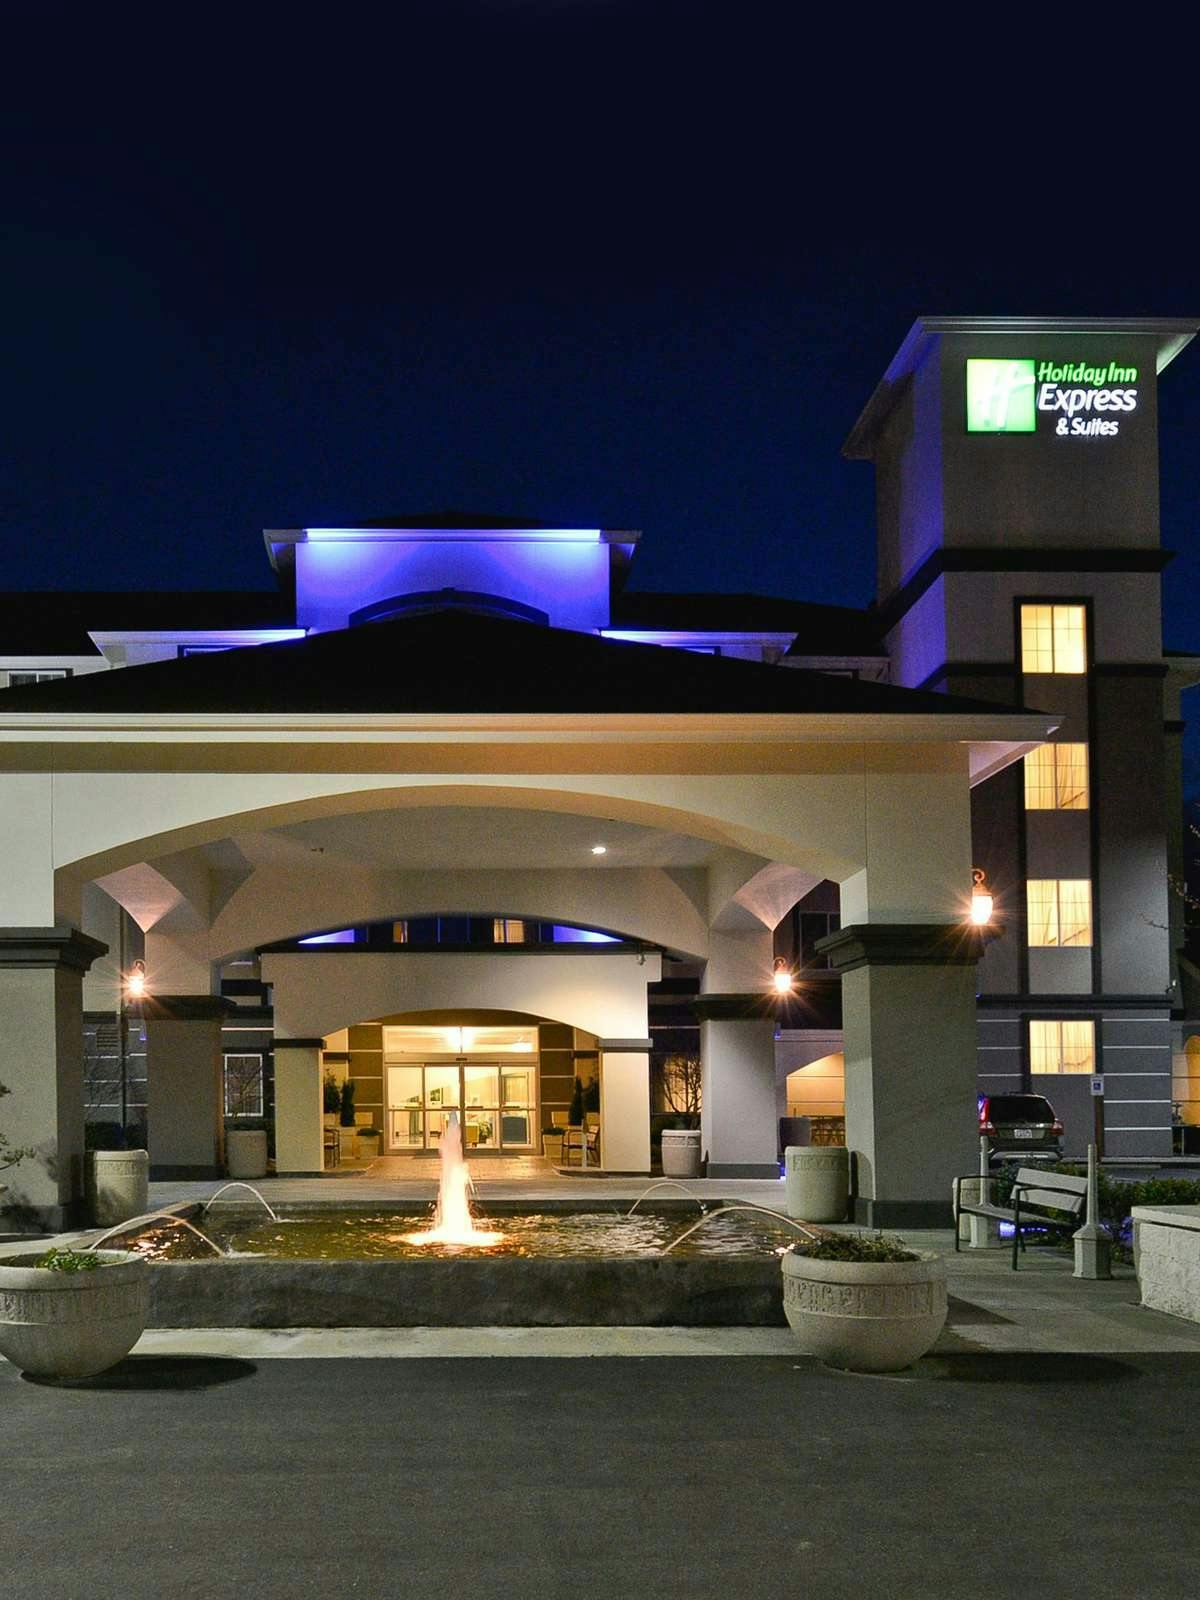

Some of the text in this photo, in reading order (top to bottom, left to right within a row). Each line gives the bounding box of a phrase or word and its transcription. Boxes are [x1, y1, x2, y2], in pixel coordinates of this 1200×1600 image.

[1038, 362, 1137, 386] Holiday Inn
[1038, 383, 1137, 417] Express
[1056, 417, 1119, 435] & Suites
